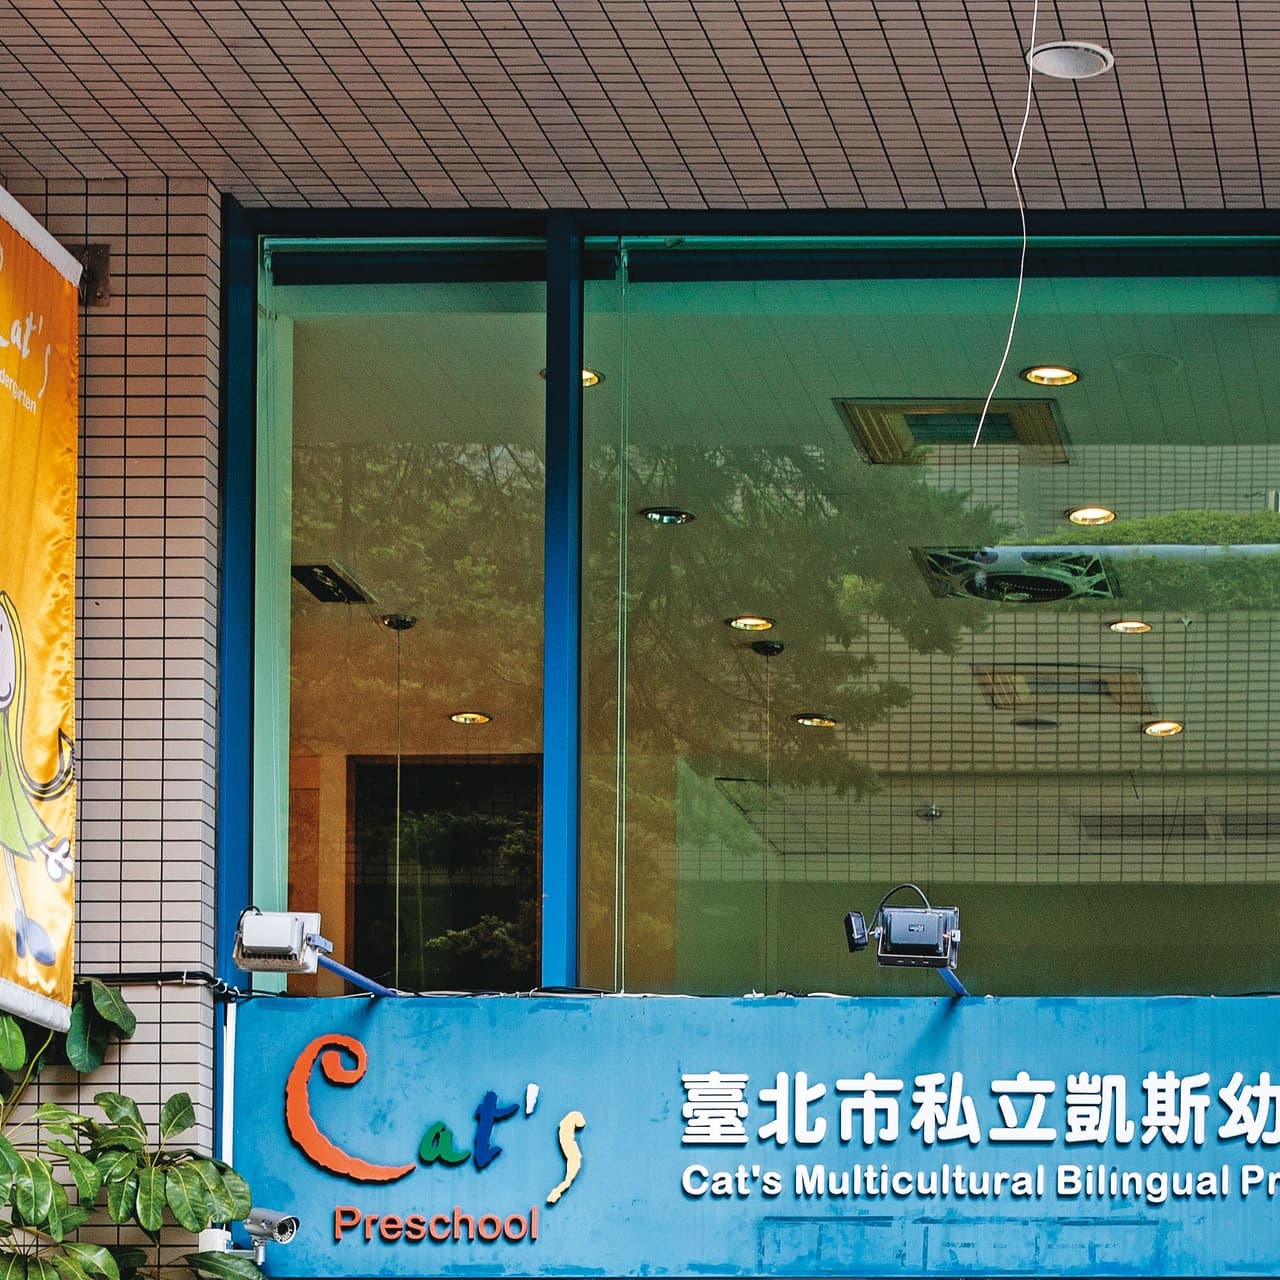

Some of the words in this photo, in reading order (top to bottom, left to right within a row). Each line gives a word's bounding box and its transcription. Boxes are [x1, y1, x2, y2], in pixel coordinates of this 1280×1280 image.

[286, 1034, 586, 1203] Cat's
[682, 1163, 781, 1197] Cat's
[795, 1163, 1044, 1197] Multicultural
[1057, 1163, 1229, 1203] Bilingual
[334, 1206, 539, 1242] Preschool
